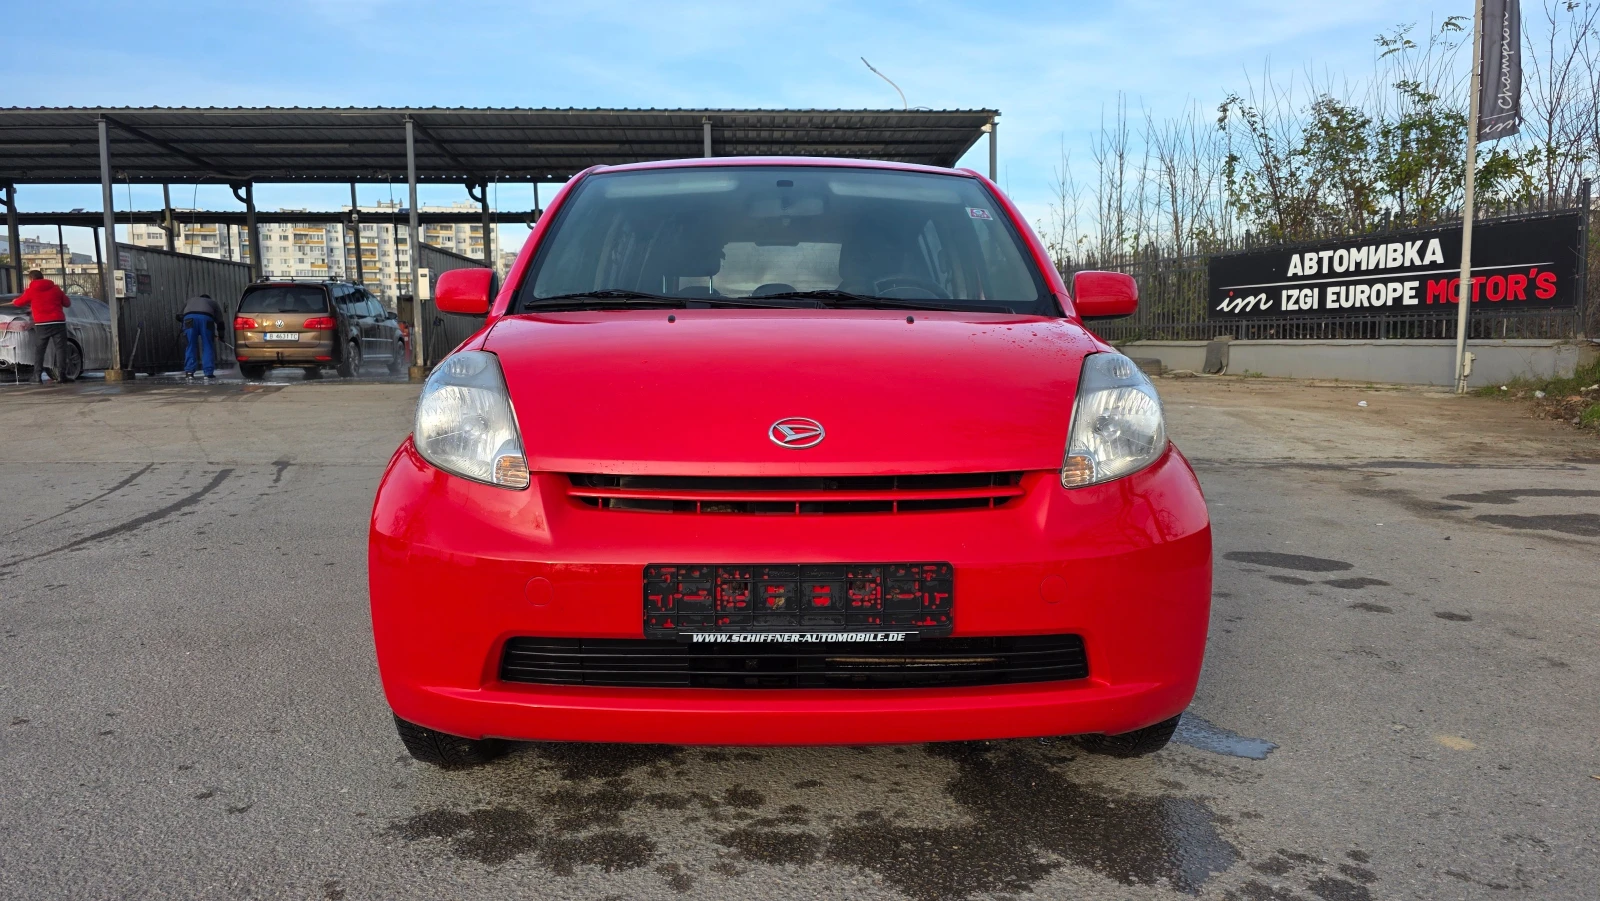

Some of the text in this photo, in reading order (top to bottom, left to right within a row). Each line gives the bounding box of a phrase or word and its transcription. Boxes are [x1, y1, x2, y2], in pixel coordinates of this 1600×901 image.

[1498, 11, 1514, 109] Champion
[1287, 238, 1444, 277] АВТОМИВКА
[1281, 288, 1319, 311] IZGI
[1326, 280, 1420, 309] EUROPE
[1426, 268, 1557, 304] MOTOR'S
[692, 632, 906, 643] WWW.SCHIFFNER-AUTOMOBILE.DE
